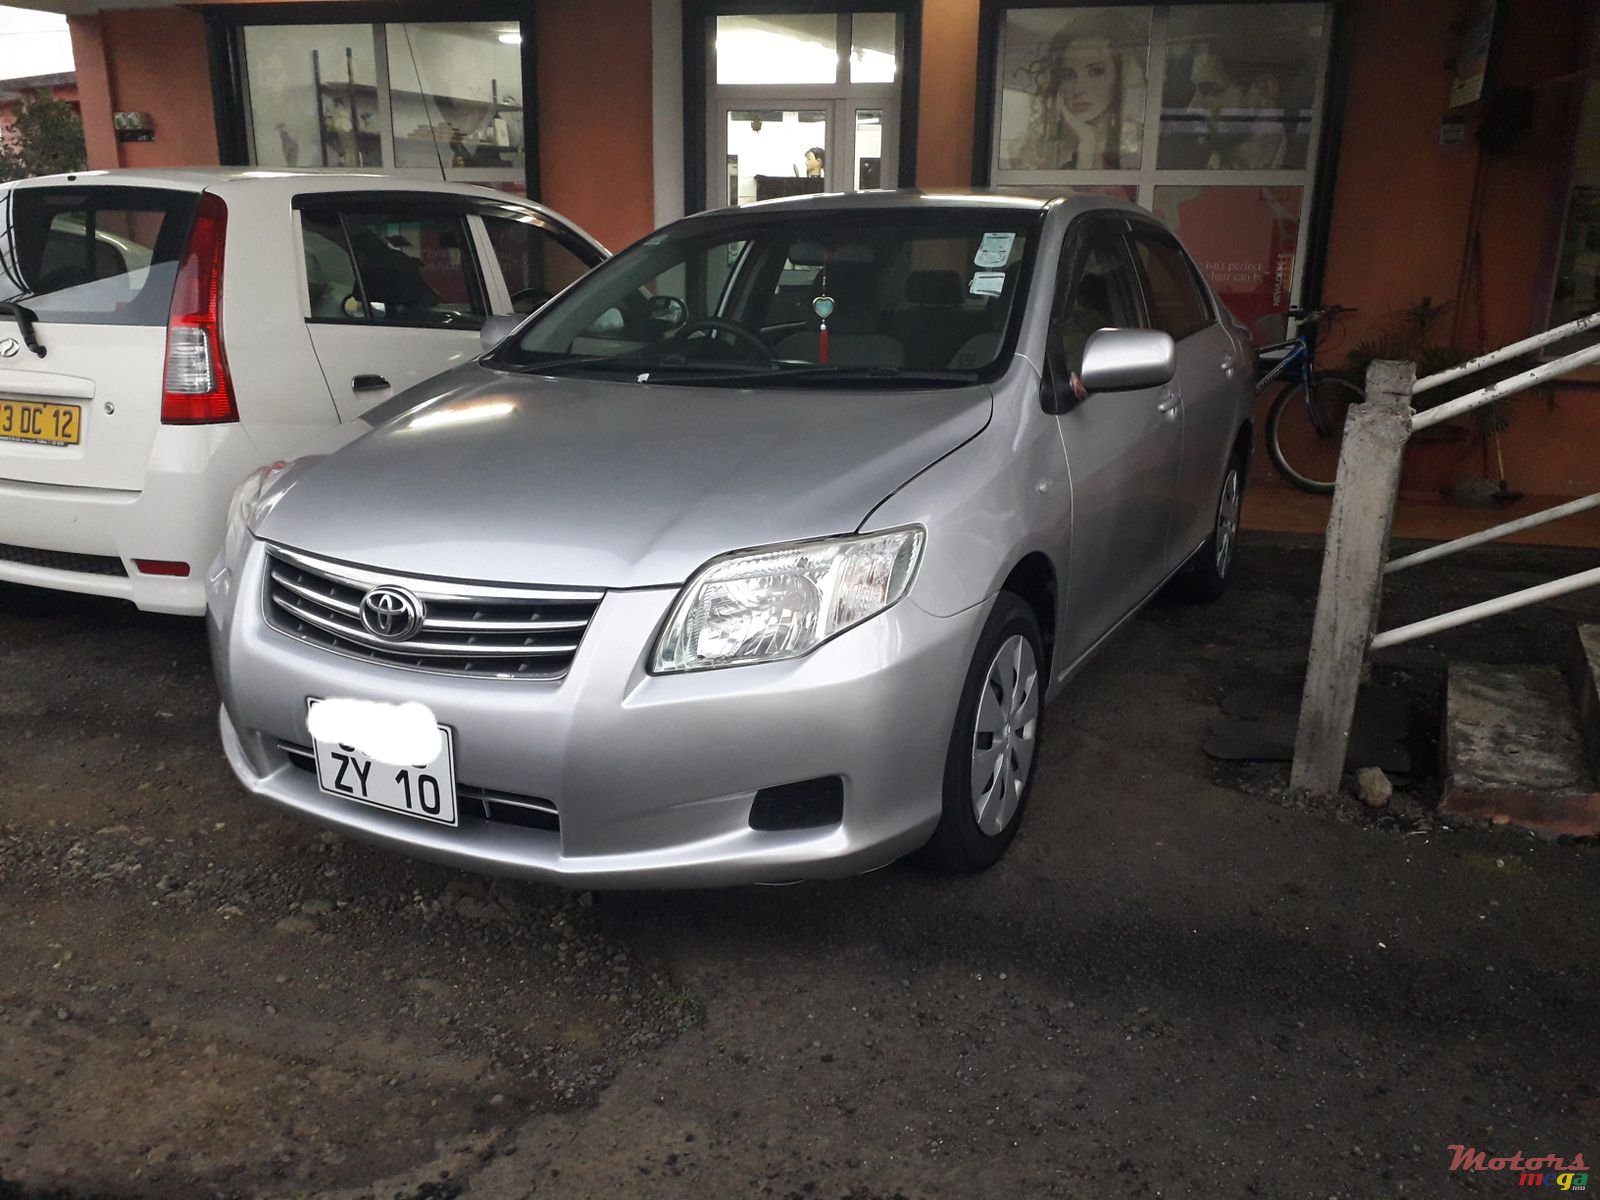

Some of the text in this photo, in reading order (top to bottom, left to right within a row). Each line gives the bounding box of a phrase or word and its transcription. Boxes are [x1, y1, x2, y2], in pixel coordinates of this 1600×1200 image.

[1228, 260, 1261, 272] perfect
[20, 405, 43, 435] DC
[53, 408, 73, 438] 12
[331, 751, 372, 798] ZY
[395, 769, 441, 815] 10
